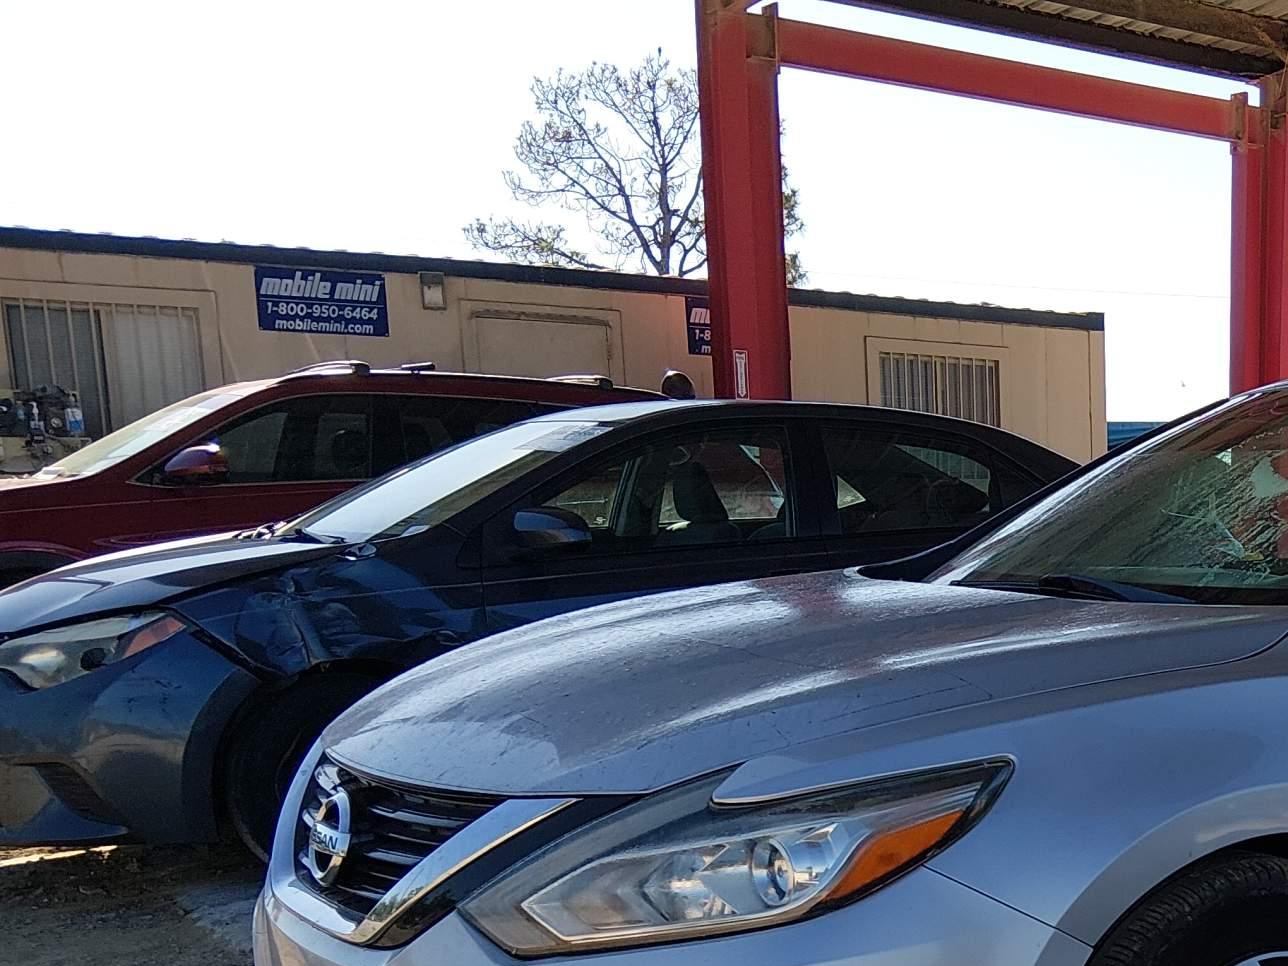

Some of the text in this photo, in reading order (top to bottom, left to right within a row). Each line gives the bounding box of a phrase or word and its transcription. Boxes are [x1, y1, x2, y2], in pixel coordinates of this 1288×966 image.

[260, 271, 383, 302] mobile mini
[266, 302, 378, 320] 1-800-950-6464
[275, 319, 374, 334] mobilemini.com
